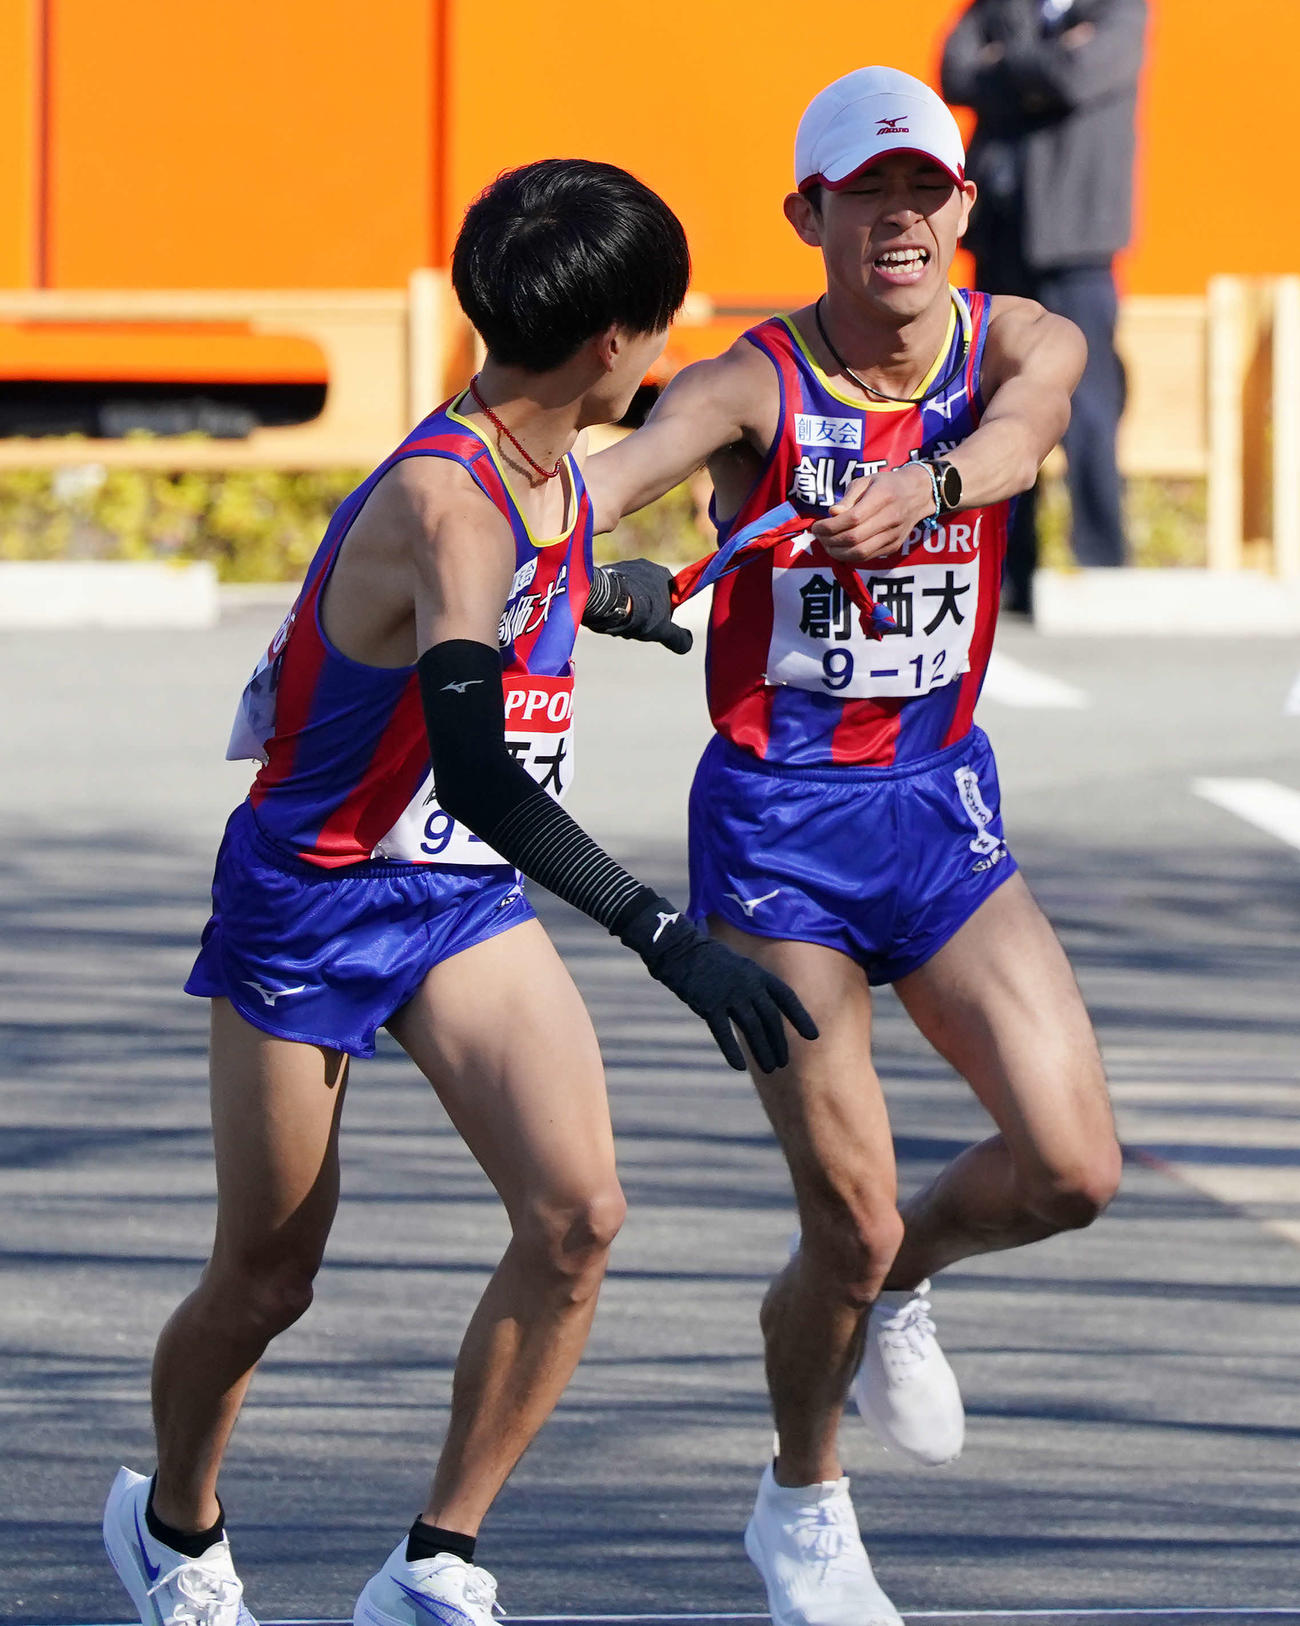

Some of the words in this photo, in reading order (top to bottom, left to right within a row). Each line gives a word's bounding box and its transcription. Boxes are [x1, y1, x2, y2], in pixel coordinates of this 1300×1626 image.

[798, 417, 858, 444] 創友会
[799, 571, 971, 641] 創価大
